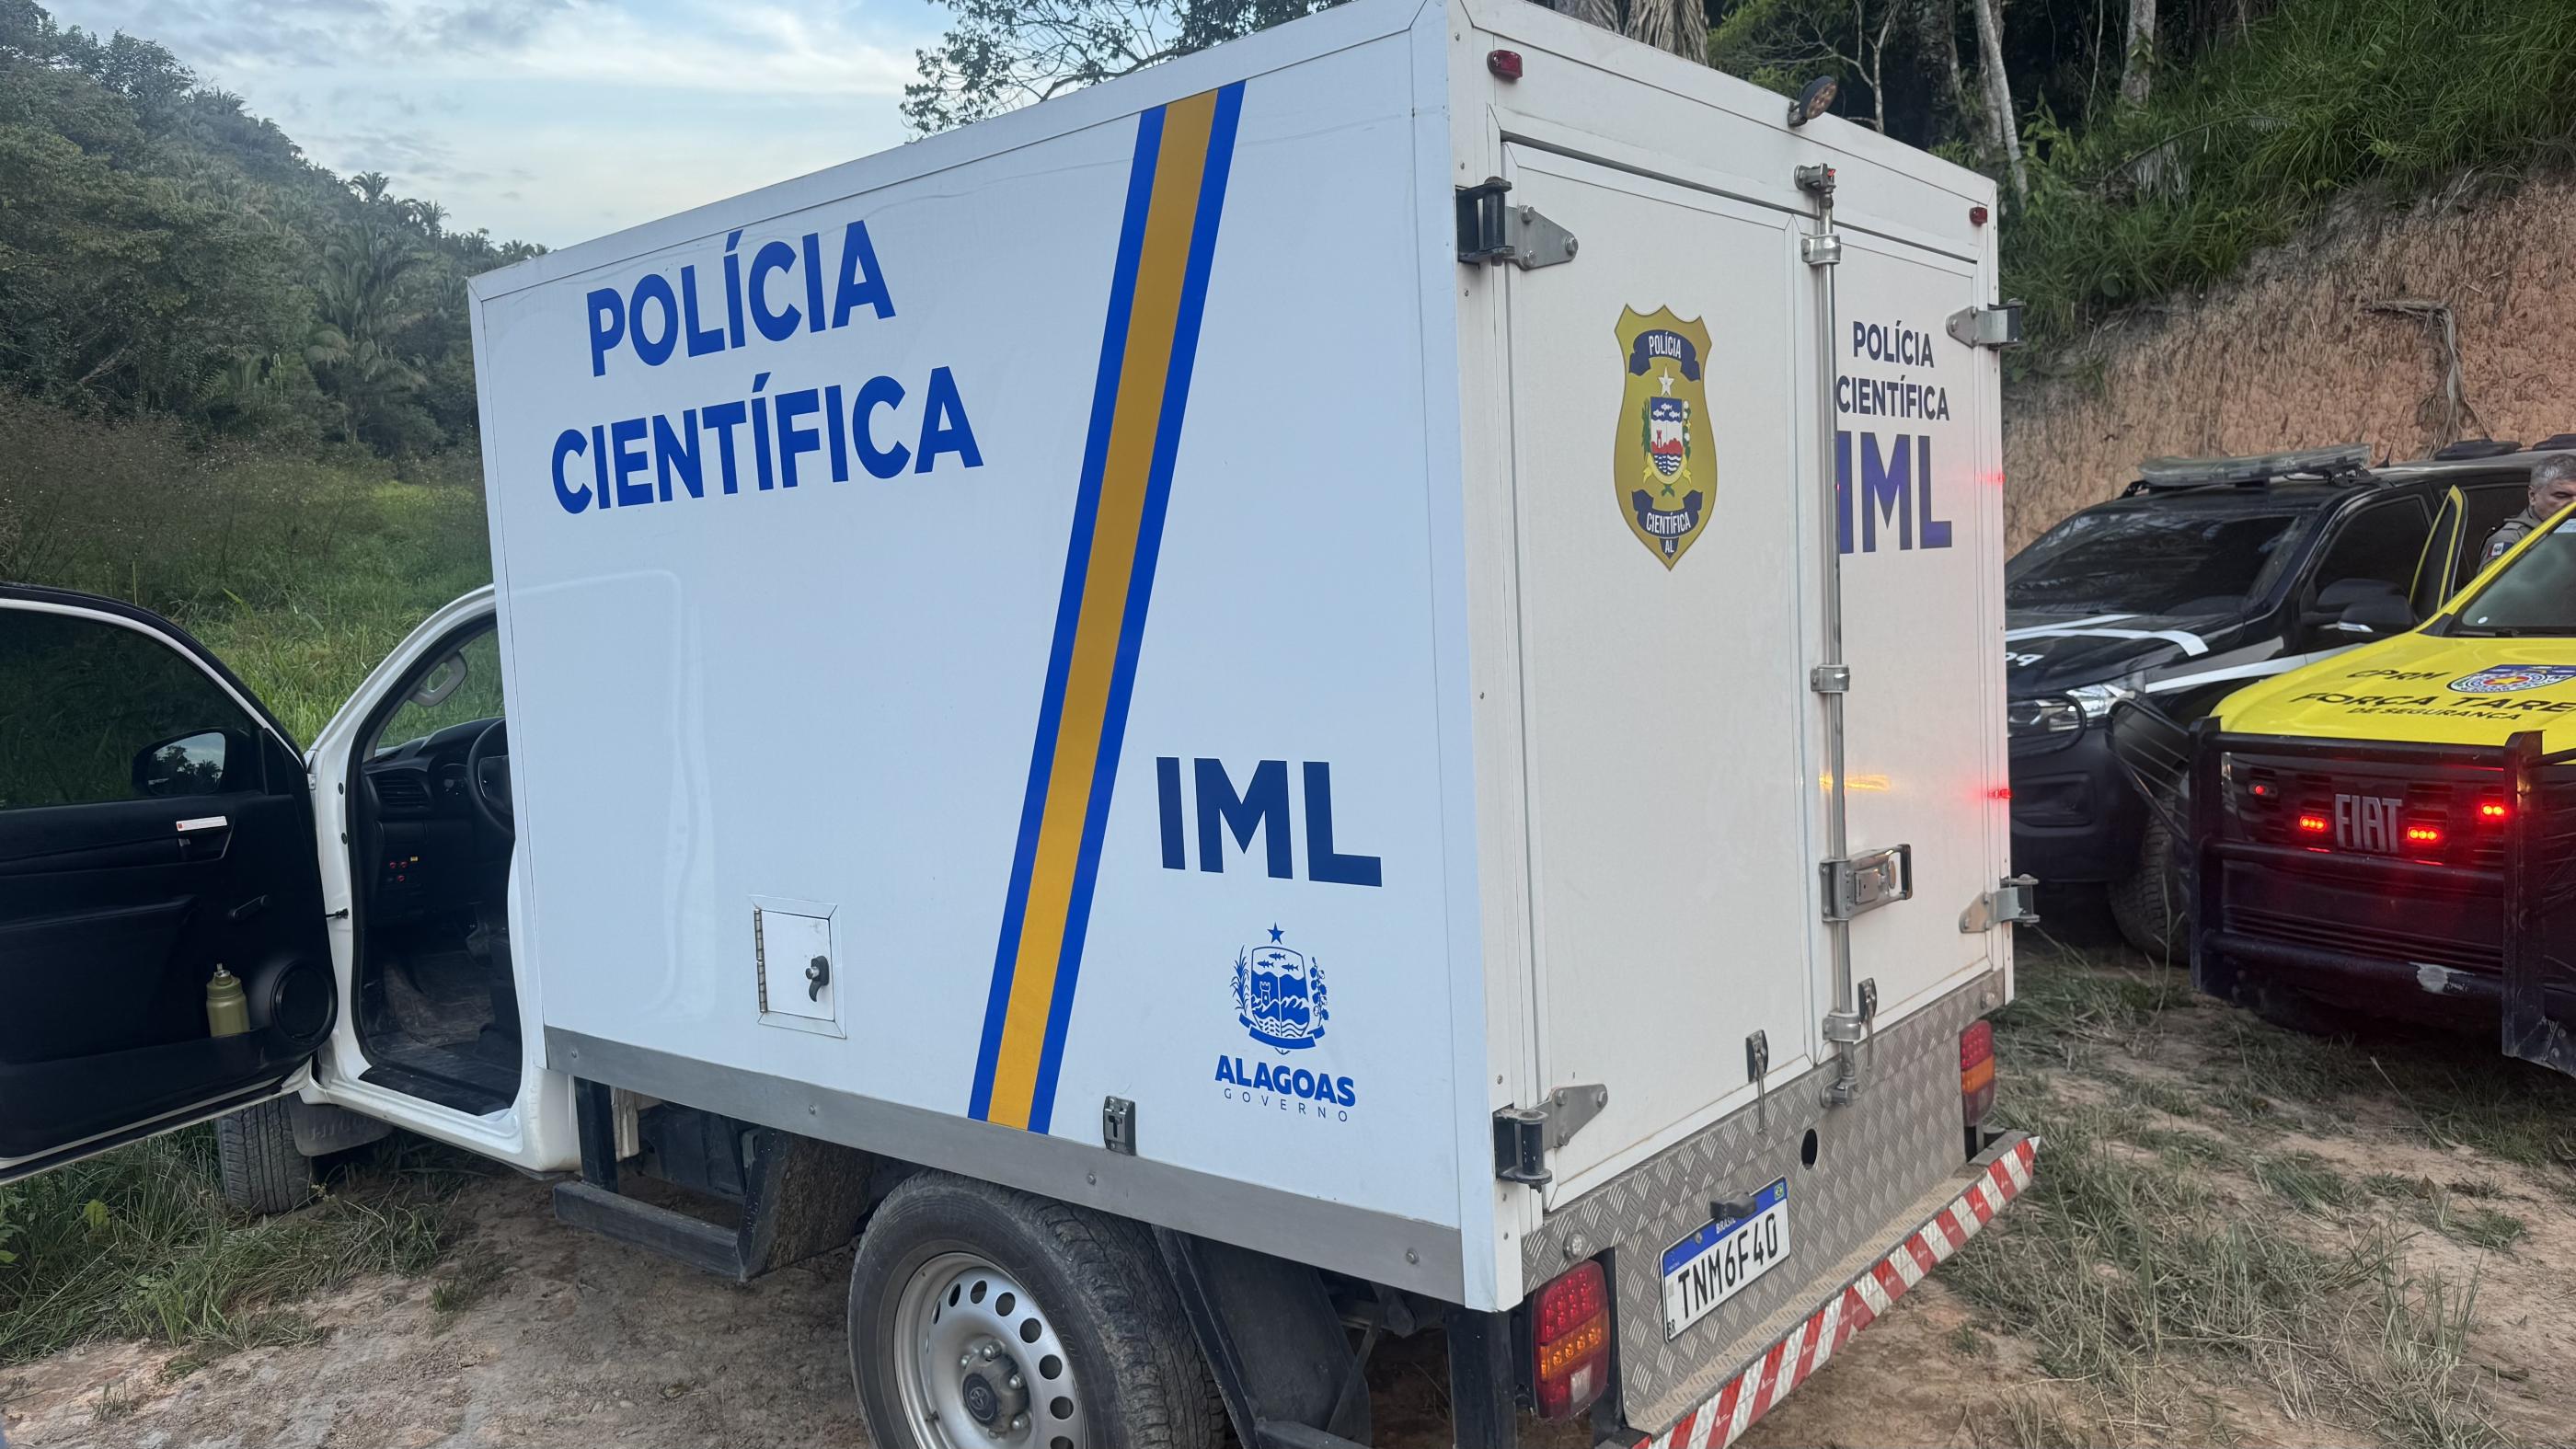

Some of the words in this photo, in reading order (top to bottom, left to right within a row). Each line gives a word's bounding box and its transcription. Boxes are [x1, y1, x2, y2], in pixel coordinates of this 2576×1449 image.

[586, 219, 896, 377] POLÍCIA
[1648, 331, 1682, 358] POLÍCIA
[1852, 319, 1935, 368] POLÍCIA
[1835, 374, 1949, 421] CIENTÍFICA
[551, 364, 984, 514] CIENTÍFICA
[1836, 430, 1952, 554] IML
[1646, 511, 1692, 535] CIENTÍFICA
[1663, 538, 1674, 554] AL
[2288, 692, 2440, 707] FORÇA
[2450, 696, 2576, 712] TARE
[2378, 707, 2522, 720] SEGURANÇA
[1156, 756, 1383, 888] IML
[2335, 793, 2403, 854] FIAT
[1214, 1054, 1357, 1108] ALAGOAS
[1223, 1087, 1349, 1122] GOVERNO
[1677, 1212, 1779, 1319] TNM6F40
[1666, 1317, 1676, 1337] BR
